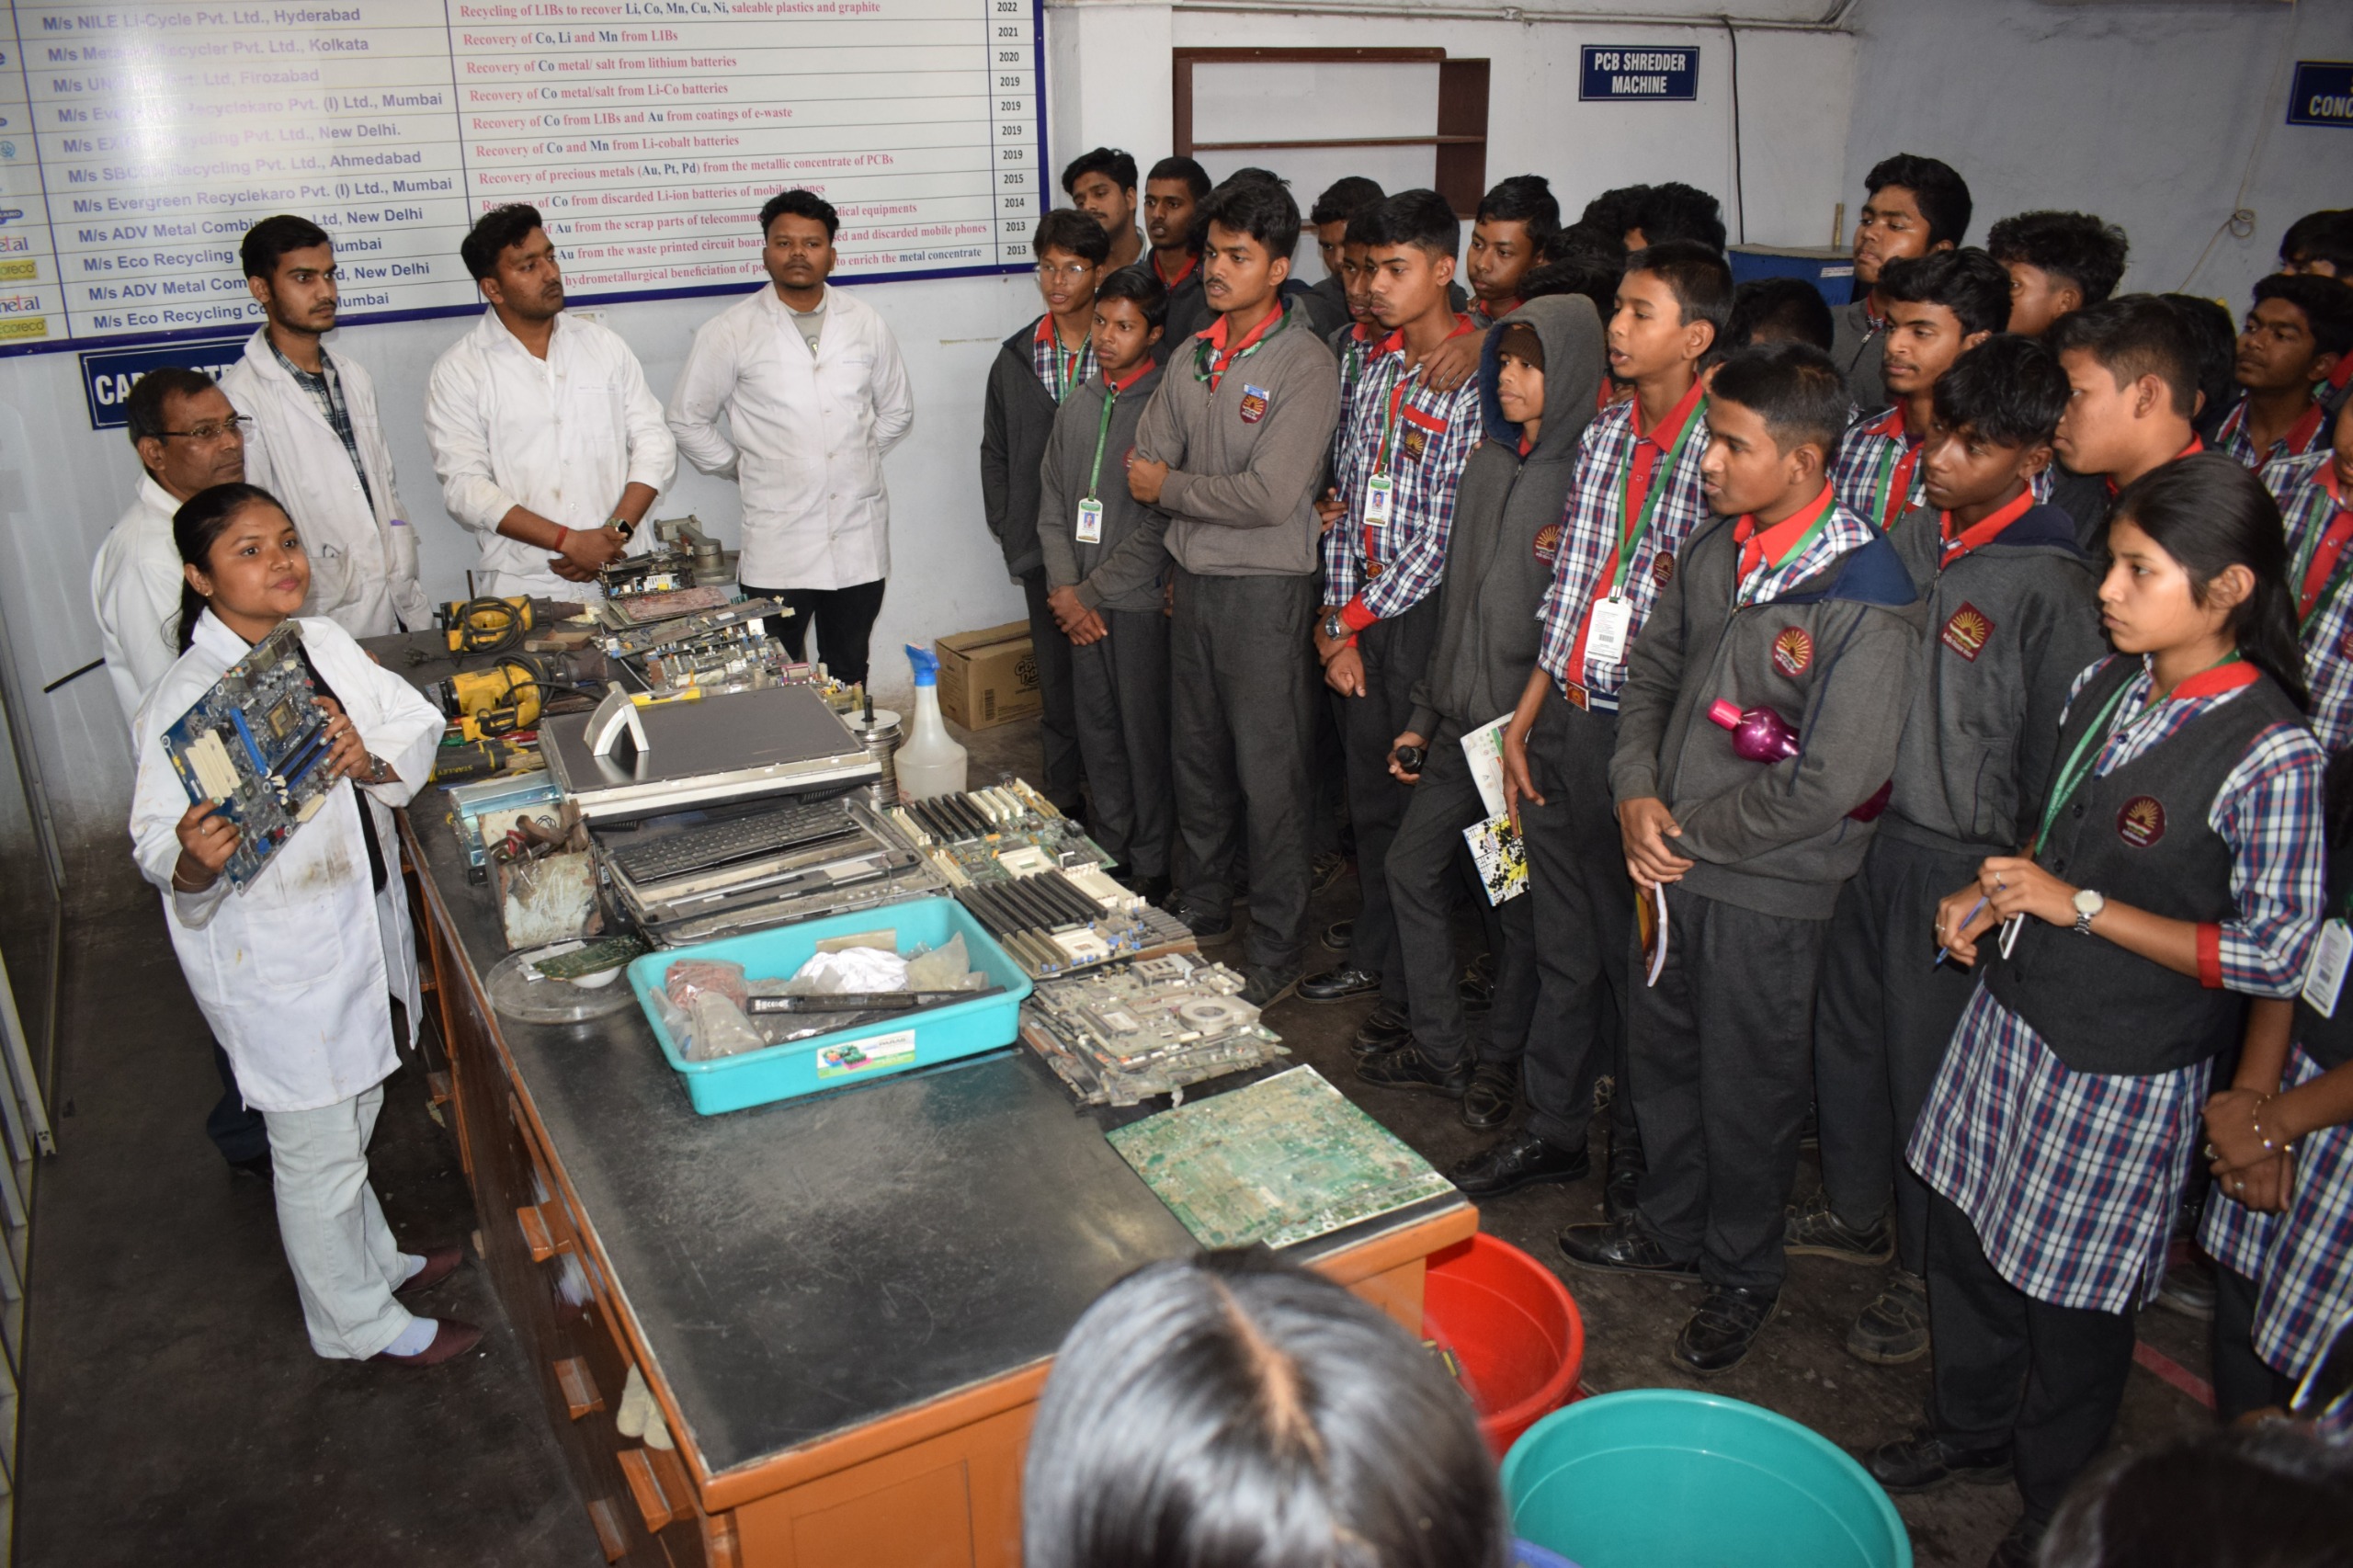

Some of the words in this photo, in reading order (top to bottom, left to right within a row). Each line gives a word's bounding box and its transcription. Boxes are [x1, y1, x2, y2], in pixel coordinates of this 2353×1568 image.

[460, 5, 518, 19] Recycling
[520, 5, 533, 17] of
[535, 5, 563, 17] LIBs
[566, 4, 577, 16] to
[581, 6, 623, 16] recover
[625, 4, 642, 17] Li,
[643, 4, 664, 17] Co,
[665, 3, 689, 17] Mn,
[691, 3, 711, 17] Cu,
[713, 3, 730, 17] Ni,
[732, 2, 773, 14] saleable
[776, 2, 814, 16] plastics
[816, 2, 835, 13] and
[838, 1, 881, 15] graphite
[997, 3, 1017, 12] 2022
[42, 17, 74, 30] M/s
[77, 15, 118, 29] NILE
[197, 12, 228, 26] Pvt.
[233, 11, 270, 26] Ltd.,
[274, 8, 360, 26] Hyderabad
[463, 34, 517, 47] Recovery
[520, 33, 533, 44] of
[535, 32, 556, 46] Co,
[559, 32, 572, 43] Li
[574, 31, 596, 43] and
[598, 31, 618, 42] Mn
[621, 30, 648, 42] from
[651, 30, 678, 41] LIBs
[998, 28, 1018, 37] 2021
[48, 48, 79, 62] M/s
[309, 38, 369, 52] Kolkata
[999, 52, 1019, 62] 2020
[467, 62, 520, 74] Recovery
[524, 61, 536, 73] of
[539, 61, 555, 72] Co
[596, 59, 616, 71] salt
[619, 59, 645, 70] from
[648, 58, 688, 69] lithium
[691, 56, 737, 68] batteries
[1594, 52, 1620, 71] PCB
[1623, 52, 1686, 72] SHREDDER
[53, 79, 83, 93] M/s
[240, 69, 320, 85] Firozabad
[1000, 77, 1020, 86] 2019
[1611, 75, 1668, 94] MACHINE
[469, 90, 524, 103] Recovery
[527, 88, 539, 100] of
[540, 88, 558, 99] Co
[618, 85, 645, 97] from
[647, 85, 679, 96] Li-Co
[682, 83, 728, 95] batteries
[57, 108, 88, 122] M/s
[344, 96, 379, 110] Ltd.,
[382, 93, 443, 108] Mumbai
[1001, 102, 1021, 111] 2019
[472, 118, 526, 131] Recovery
[529, 116, 542, 128] of
[544, 115, 561, 127] Co
[563, 115, 590, 127] from
[594, 113, 621, 125] LIBs
[624, 112, 644, 124] and
[647, 112, 664, 123] Au
[667, 111, 693, 123] from
[696, 109, 739, 122] coatings
[742, 108, 752, 120] of
[755, 108, 793, 119] e-waste
[63, 139, 92, 153] M/s
[318, 127, 352, 140] New
[1002, 126, 1022, 135] 2019
[476, 145, 529, 157] Recovery
[533, 142, 544, 154] of
[546, 142, 563, 154] Co
[566, 142, 587, 153] and
[590, 141, 610, 153] Mn
[612, 140, 640, 151] from
[642, 137, 690, 150] Li-cobalt
[693, 136, 740, 148] batteries
[1003, 150, 1023, 160] 2019
[68, 169, 97, 183] M/s
[329, 151, 422, 168] Ahmedabad
[479, 173, 532, 184] Recovery
[535, 170, 548, 182] of
[550, 168, 597, 183] precious
[599, 166, 635, 178] metals
[664, 165, 680, 177] Pt,
[703, 163, 729, 174] from
[732, 161, 748, 172] the
[750, 159, 791, 171] metallic
[794, 156, 851, 169] concentrate
[854, 155, 866, 166] of
[866, 154, 894, 165] PCBs
[1004, 175, 1024, 184] 2015
[74, 199, 103, 213] M/s
[107, 196, 191, 211] Evergreen
[197, 188, 296, 207] Recyclekaro
[300, 186, 331, 199] Pvt.
[355, 182, 389, 196] Ltd.,
[392, 177, 452, 193] Mumbai
[539, 197, 550, 209] of
[552, 196, 568, 208] Co
[572, 195, 598, 207] from
[601, 191, 654, 205] discarded
[657, 189, 689, 202] Li-ion
[692, 187, 737, 199] batteries
[741, 186, 751, 198] of
[1005, 199, 1025, 208] 2014
[79, 229, 107, 243] M/s
[112, 226, 148, 241] ADV
[153, 222, 197, 238] Metal
[347, 211, 380, 224] New
[384, 208, 423, 222] Delhi
[555, 222, 572, 233] Au
[575, 222, 602, 233] from
[605, 220, 622, 231] the
[625, 220, 654, 232] scrap
[657, 216, 684, 231] parts
[688, 215, 699, 226] of
[862, 202, 917, 219] equipments
[1006, 222, 1026, 232] 2013
[577, 248, 604, 258] from
[607, 246, 625, 256] the
[627, 244, 657, 256] waste
[660, 241, 699, 256] printed
[701, 239, 734, 251] circuit
[851, 231, 870, 241] and
[871, 227, 918, 240] discarded
[921, 225, 952, 236] mobile
[954, 224, 987, 237] phones
[1006, 245, 1027, 255] 2013
[83, 258, 112, 272] M/s
[118, 256, 149, 269] Eco
[154, 250, 233, 267] Recycling
[564, 268, 667, 289] hydrometallurgical
[671, 265, 736, 278] beneficiation
[739, 263, 750, 274] of
[849, 254, 879, 266] enrich
[882, 253, 897, 264] the
[899, 251, 926, 262] metal
[928, 247, 982, 260] concentrate
[88, 287, 118, 301] M/s
[121, 283, 157, 299] ADV
[162, 279, 206, 295] Metal
[355, 267, 387, 280] New
[392, 262, 430, 278] Delhi
[94, 314, 123, 329] M/s
[127, 312, 158, 326] Eco
[164, 306, 243, 324] Recycling
